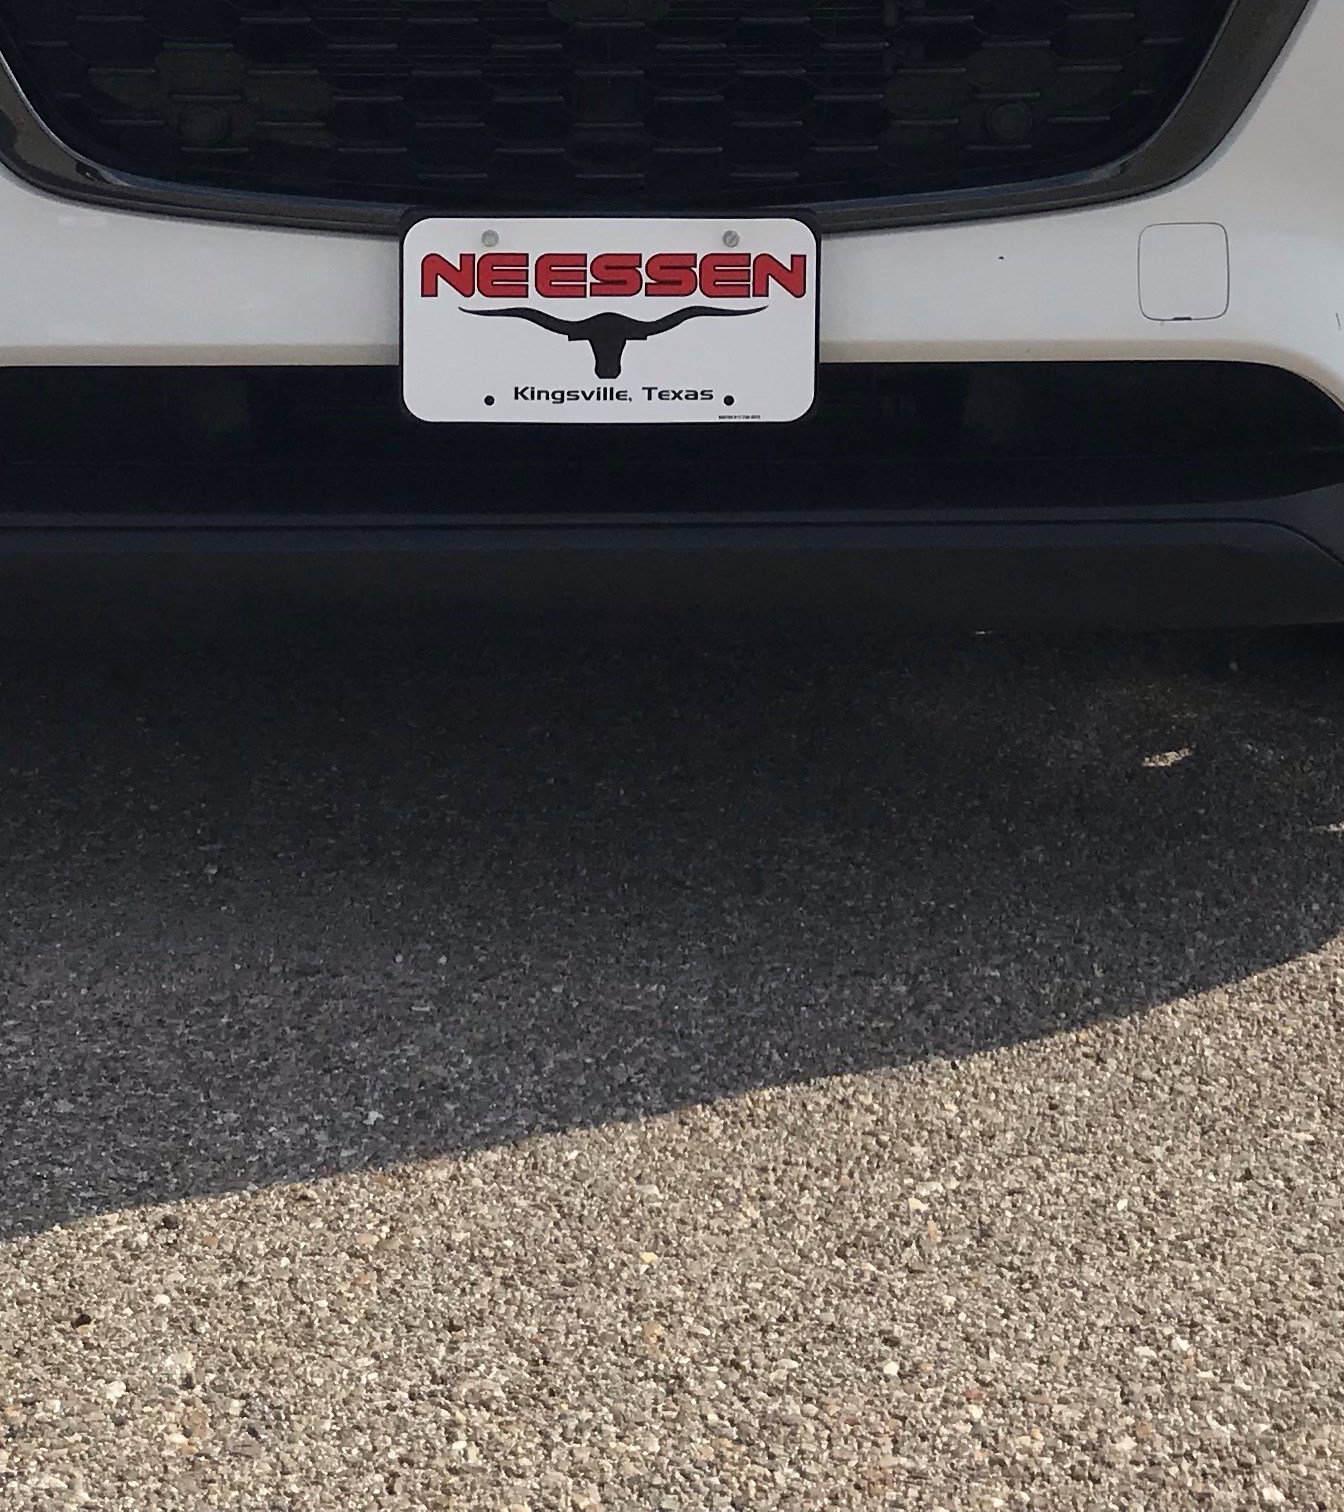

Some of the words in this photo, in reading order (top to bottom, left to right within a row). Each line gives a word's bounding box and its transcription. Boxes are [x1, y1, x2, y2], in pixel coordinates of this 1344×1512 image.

[420, 252, 806, 298] NEESSEN
[514, 386, 632, 404] Kingsville,
[642, 386, 714, 402] Texas
